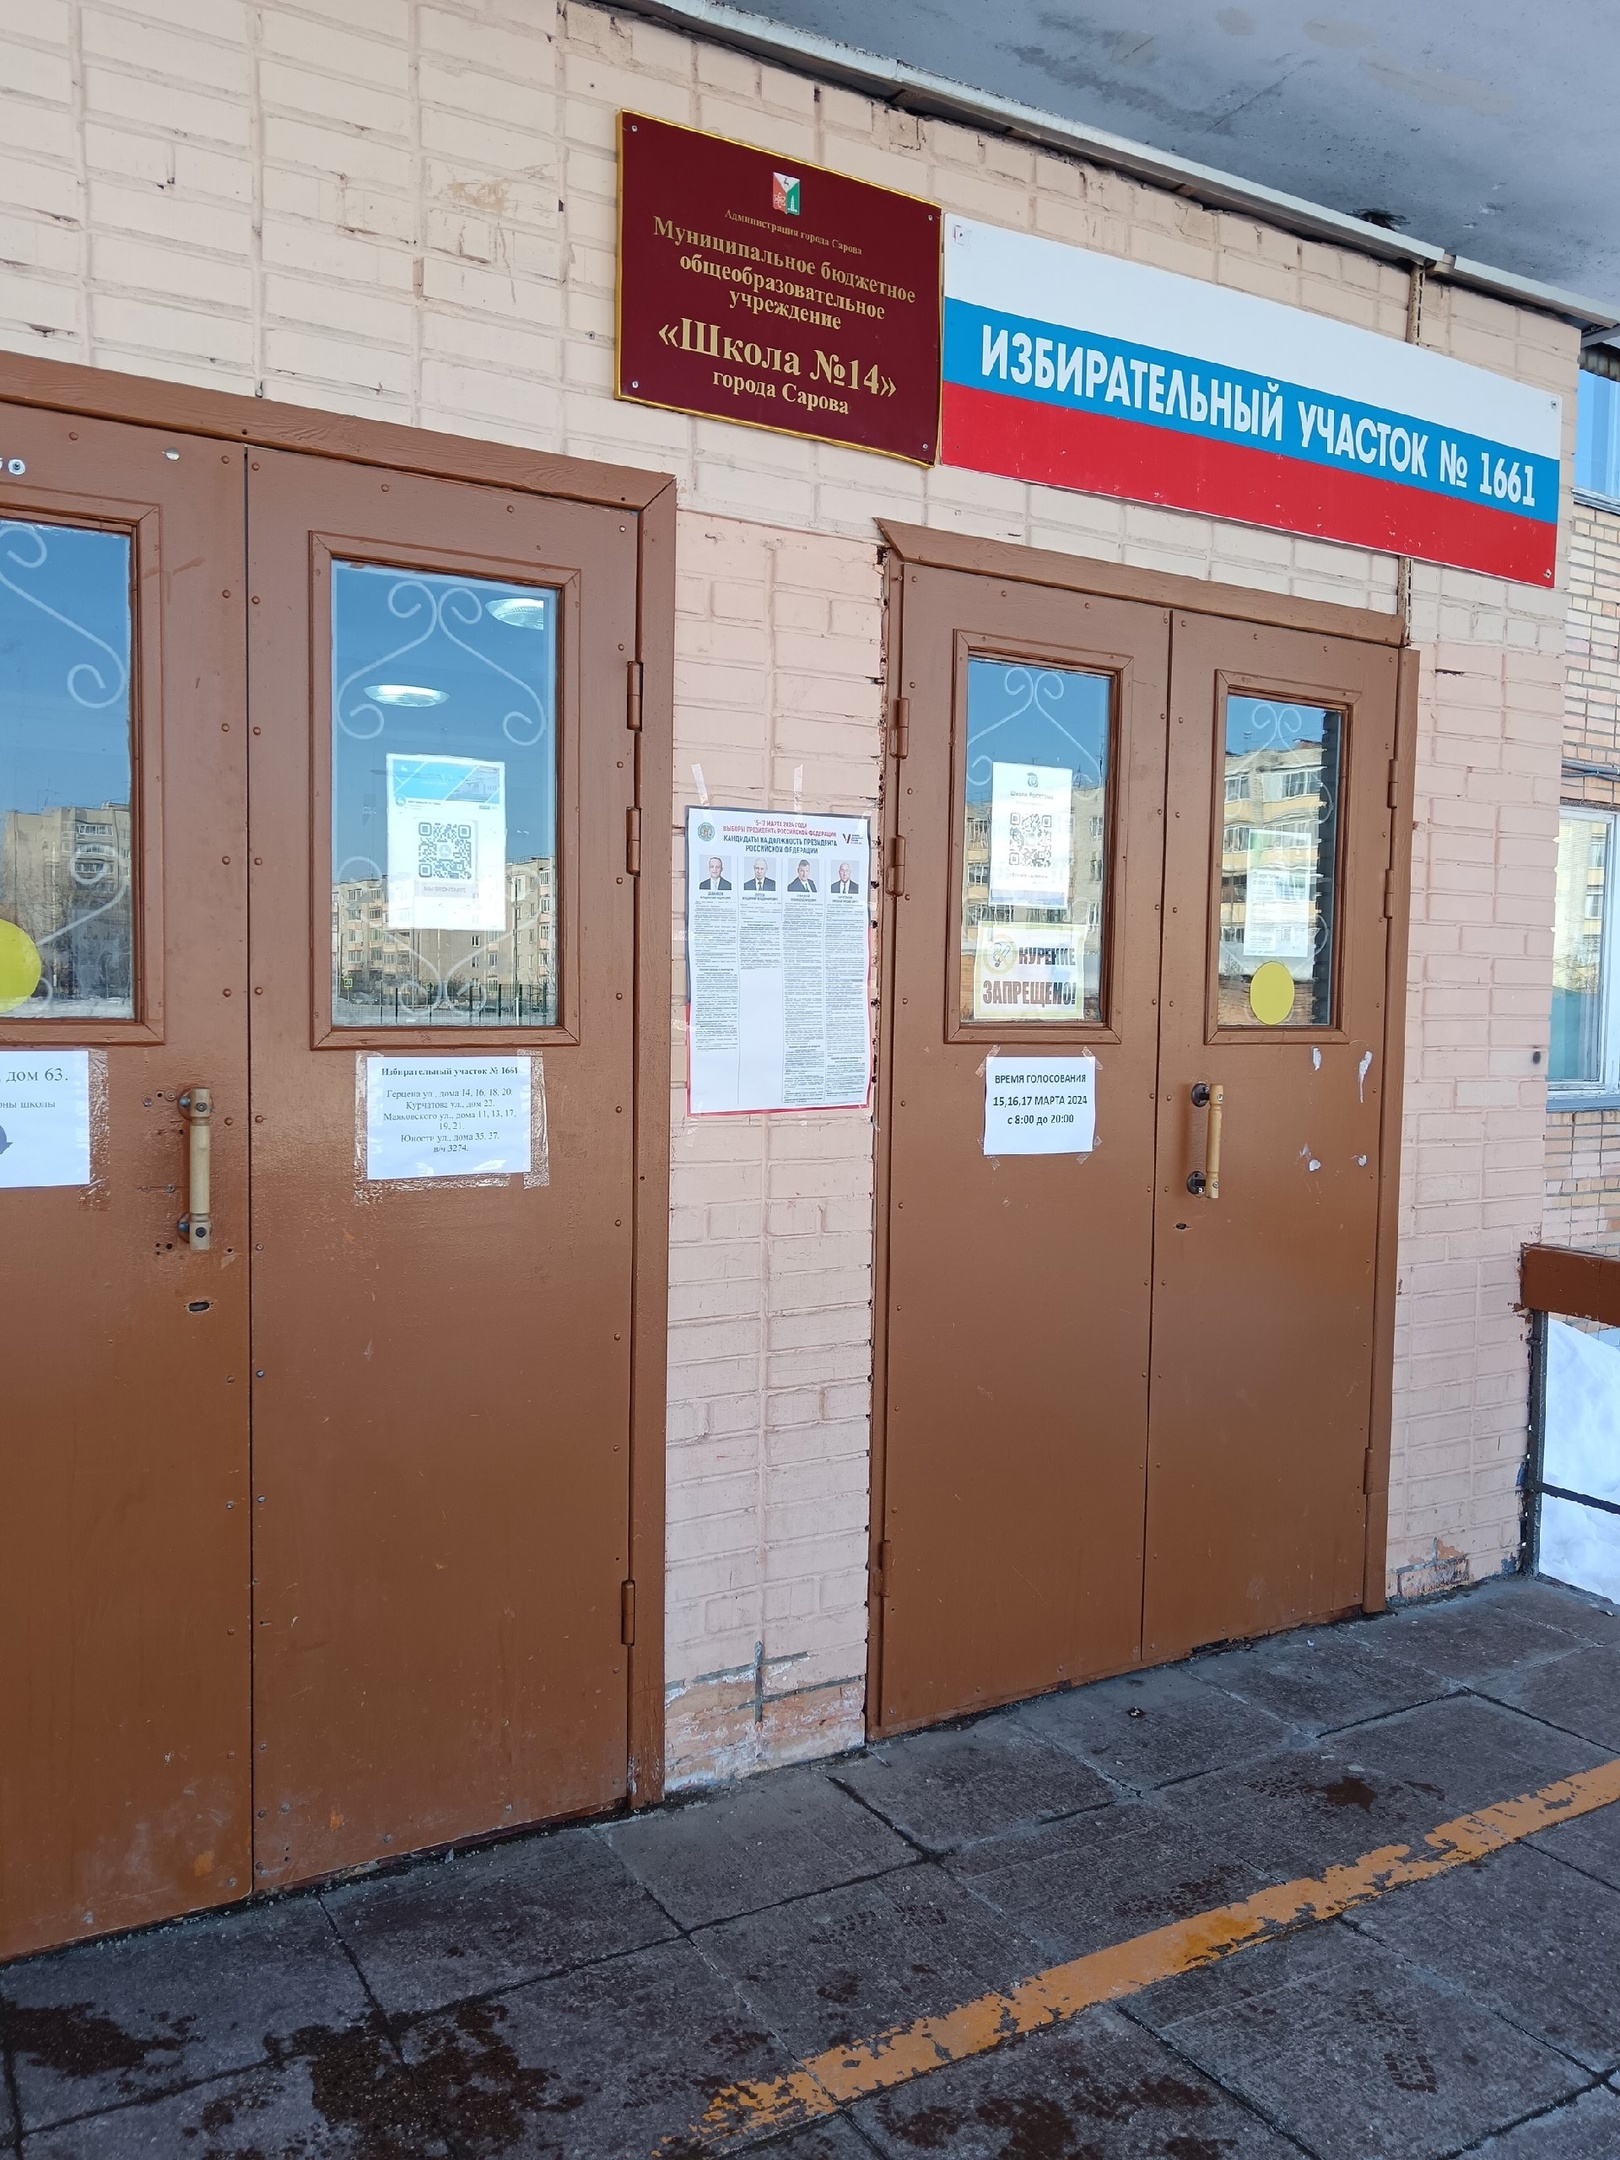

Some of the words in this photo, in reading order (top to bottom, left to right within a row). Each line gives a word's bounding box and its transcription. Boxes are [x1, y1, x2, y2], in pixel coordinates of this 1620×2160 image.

[724, 209, 799, 237] Администрация
[800, 229, 830, 246] города
[831, 238, 863, 256] Сарова
[653, 215, 816, 275] Муниципальное
[820, 261, 916, 303] бюджетное
[679, 253, 886, 320] общеобразовательное
[729, 290, 842, 330] учреждение
[658, 317, 801, 377] «Школа
[809, 349, 897, 398] №14»
[712, 371, 777, 398] города
[781, 383, 849, 415] Сарова
[981, 324, 1284, 441] ИЗБИРАТЕЛЬНЫЙ
[1298, 401, 1429, 478] УЧАСТОК
[1439, 440, 1468, 488] №
[1479, 452, 1535, 507] 1661
[1018, 947, 1076, 966] КУРЕНИЕ
[982, 980, 1077, 1008] ЗАПРЕЩЕНО!
[6, 1071, 39, 1083] дом
[44, 1067, 69, 1082] 63.
[381, 1067, 452, 1078] Избирательный
[453, 1068, 488, 1078] участок
[994, 1074, 1025, 1084] ВРЕМЯ
[1026, 1074, 1087, 1084] ГОЛОСОВАНИЯ
[386, 1089, 421, 1100] Герцена
[993, 1096, 1033, 1108] 15,16,17
[1034, 1095, 1066, 1105] МАРТА
[1067, 1095, 1088, 1105] 2024
[20, 1101, 56, 1109] школы
[405, 1101, 448, 1111] Курчатова
[383, 1112, 438, 1121] Маяковского
[455, 1112, 476, 1120] дома
[1007, 1117, 1013, 1125] с
[1014, 1114, 1035, 1125] 8:00
[1036, 1116, 1048, 1126] до
[1050, 1114, 1074, 1124] 20:00
[400, 1134, 435, 1143] Юности
[453, 1134, 474, 1142] дома
